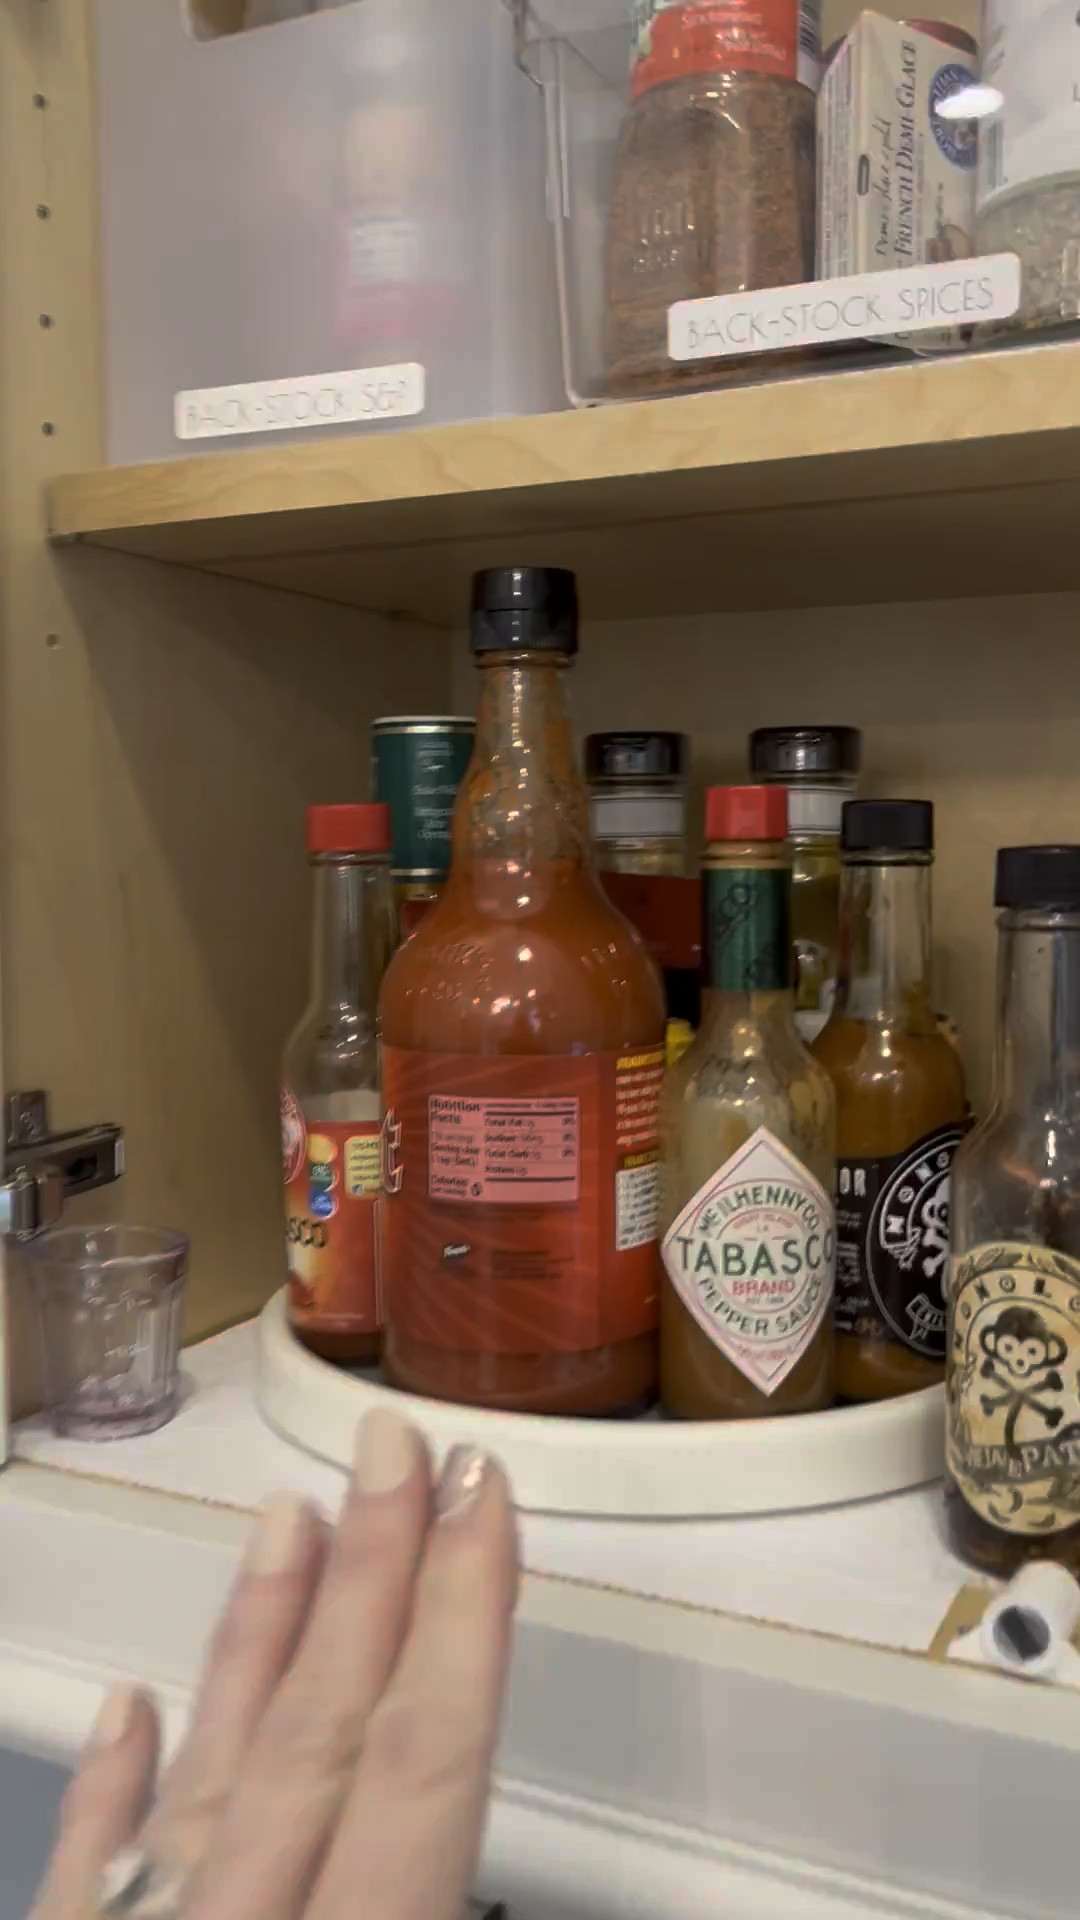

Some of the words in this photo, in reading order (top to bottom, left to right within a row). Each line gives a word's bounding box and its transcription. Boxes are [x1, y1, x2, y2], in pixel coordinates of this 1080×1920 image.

[893, 176, 914, 257] FRENCH
[686, 293, 885, 350] BACK-STOCK
[899, 277, 994, 321] SPICES
[676, 1228, 835, 1276] TABASCO
[698, 1276, 770, 1337] PEPPER
[732, 1279, 796, 1297] BRAND
